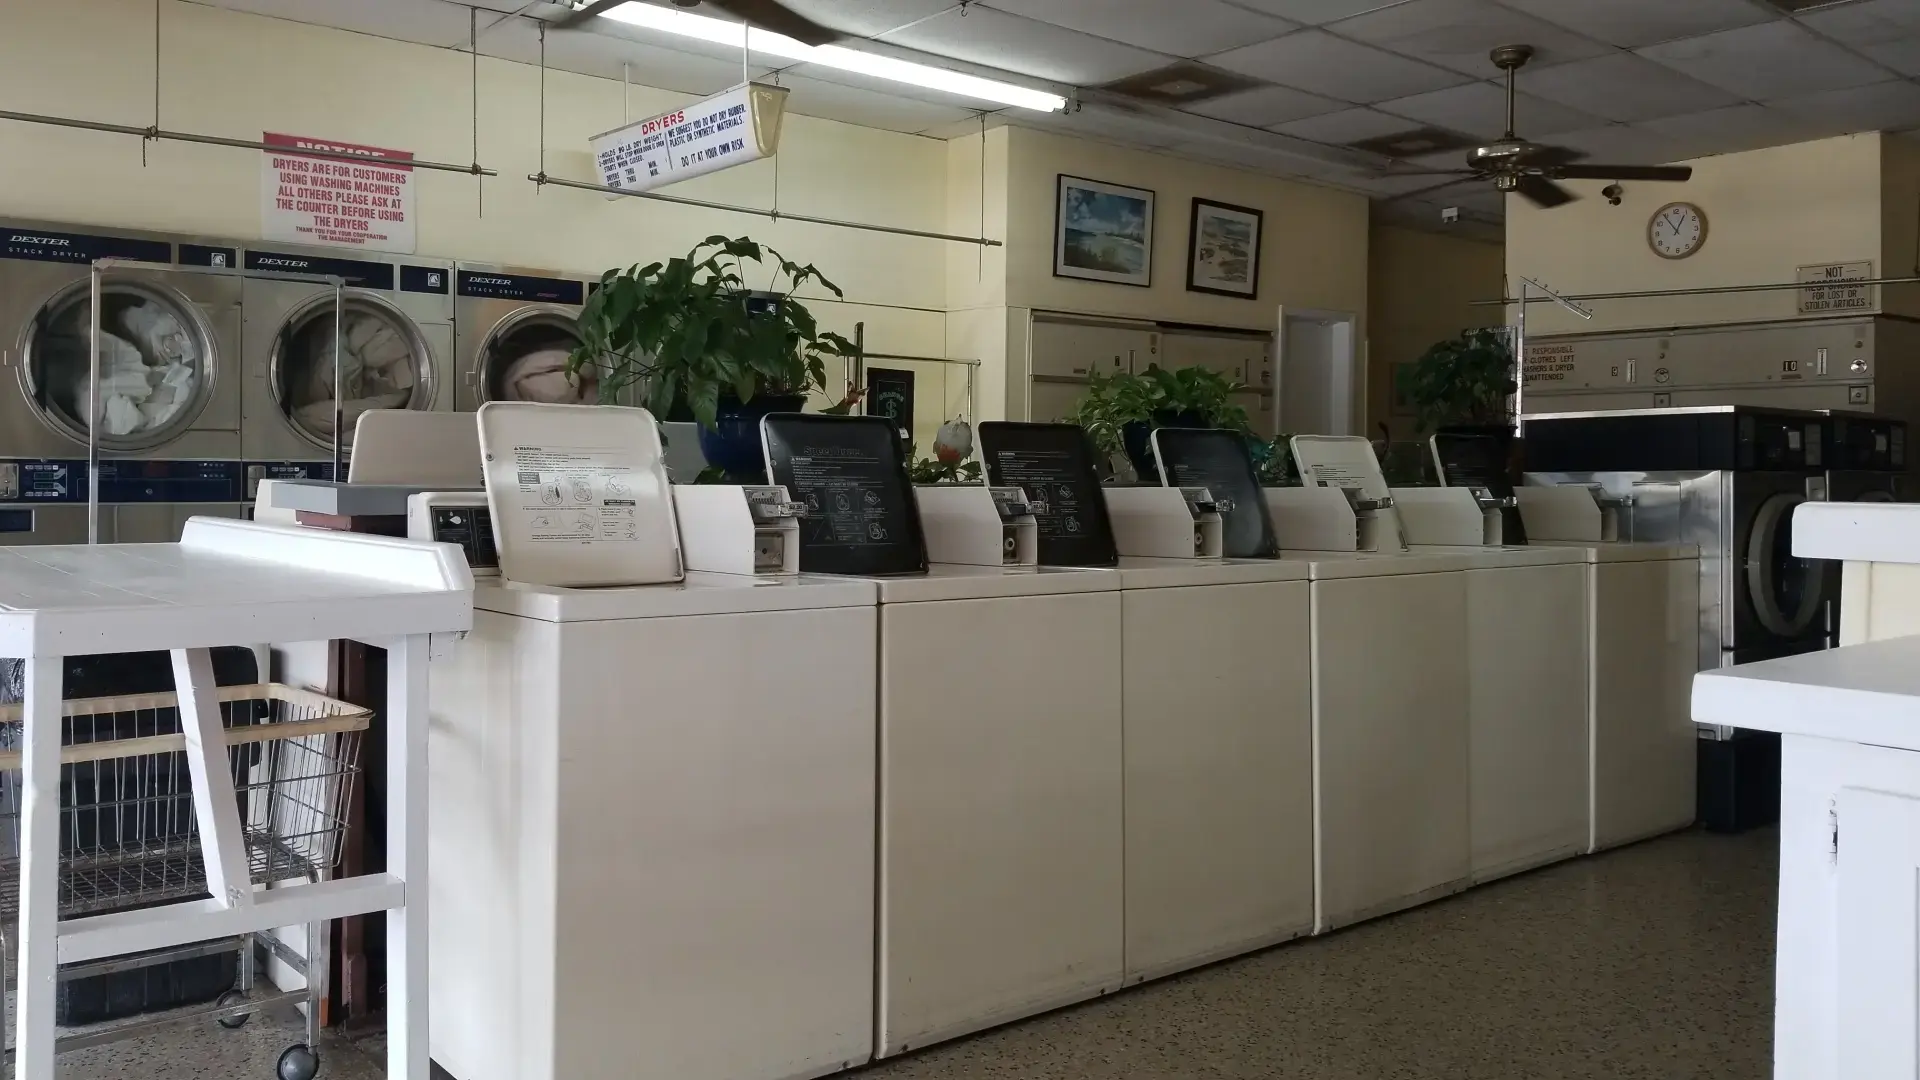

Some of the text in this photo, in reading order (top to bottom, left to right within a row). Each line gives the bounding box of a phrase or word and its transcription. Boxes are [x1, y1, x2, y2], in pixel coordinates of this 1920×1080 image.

[642, 111, 685, 135] DRYERS
[668, 128, 675, 138] WE
[676, 122, 692, 135] SUGGEST
[693, 120, 701, 129] YOU
[703, 117, 709, 126] DO
[710, 114, 718, 124] NOT
[633, 140, 642, 148] DRY
[644, 133, 662, 145] WEIGHT
[670, 135, 686, 148] PLASTIC
[687, 132, 692, 142] OR
[694, 125, 715, 140] SYNTHETIC
[625, 150, 633, 158] STOP
[643, 145, 652, 153] DOOR
[656, 140, 664, 148] OPEN
[681, 138, 744, 167] DO IT AT YOUR OWN RISK
[273, 158, 406, 184] DRYERS ARE FOR CUSTOMERS
[604, 164, 616, 173] STARTS
[618, 160, 628, 168] WHEN
[606, 172, 619, 182] DRYERS
[625, 168, 634, 176] THRU
[627, 175, 636, 183] THRU
[280, 172, 400, 196] USING WASHING MACHINES
[278, 185, 402, 209] ALL OTHERS PLEASE ASK AT
[276, 198, 404, 222] THE COUNTER BEFORE USING
[314, 216, 369, 231] THE DRYERS
[9, 235, 70, 246] DEXTER
[329, 236, 365, 244] MANAGEMENT
[353, 232, 388, 240] COOPERATION
[8, 246, 86, 258] STACK DRYER
[257, 257, 308, 268] DEXTER
[1826, 266, 1843, 278] NOT
[469, 276, 512, 286] DEXTER
[1812, 290, 1856, 300] FOR LOST OR
[1805, 298, 1865, 310] STOLEN ARTICLES
[1532, 345, 1573, 354] RESPONSIBLE
[1785, 361, 1797, 371] 10
